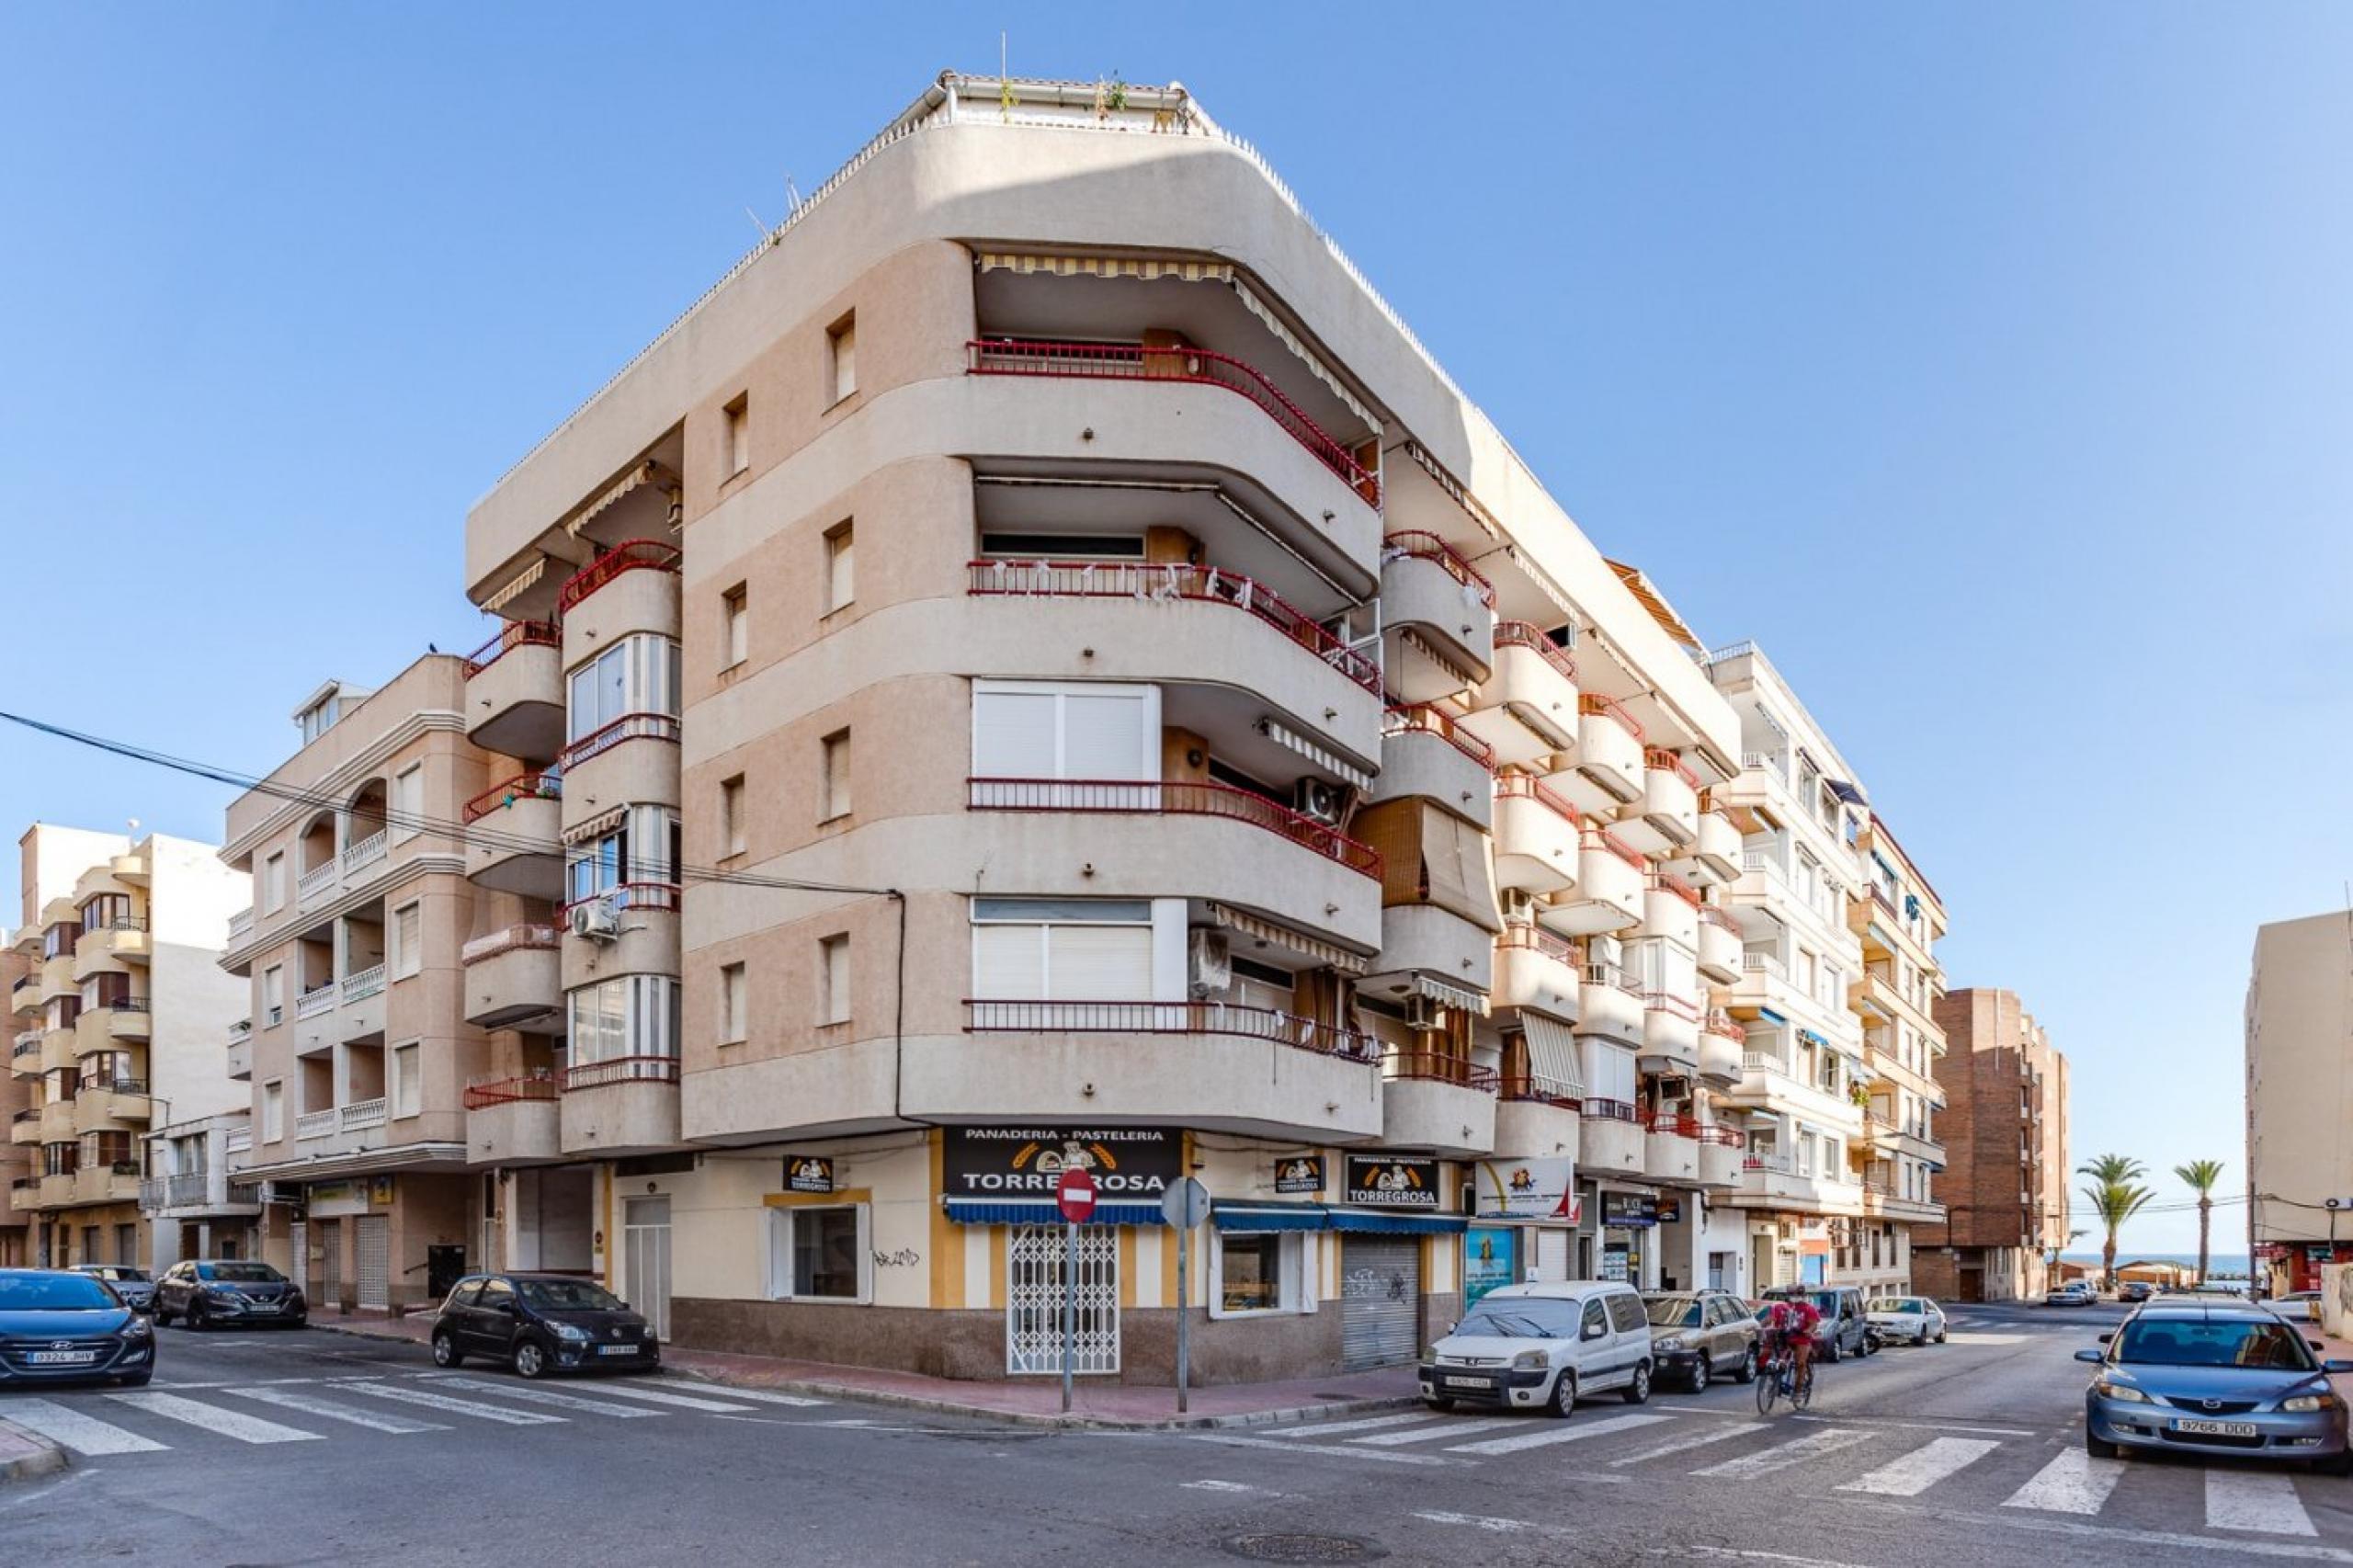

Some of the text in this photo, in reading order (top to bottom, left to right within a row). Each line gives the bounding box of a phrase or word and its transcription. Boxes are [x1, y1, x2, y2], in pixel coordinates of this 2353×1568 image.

[965, 1129, 1059, 1140] PANADERIA
[1072, 1131, 1164, 1141] PASTELERIA
[962, 1174, 1165, 1191] TORREROSA
[1349, 1189, 1435, 1203] TORREGROSA
